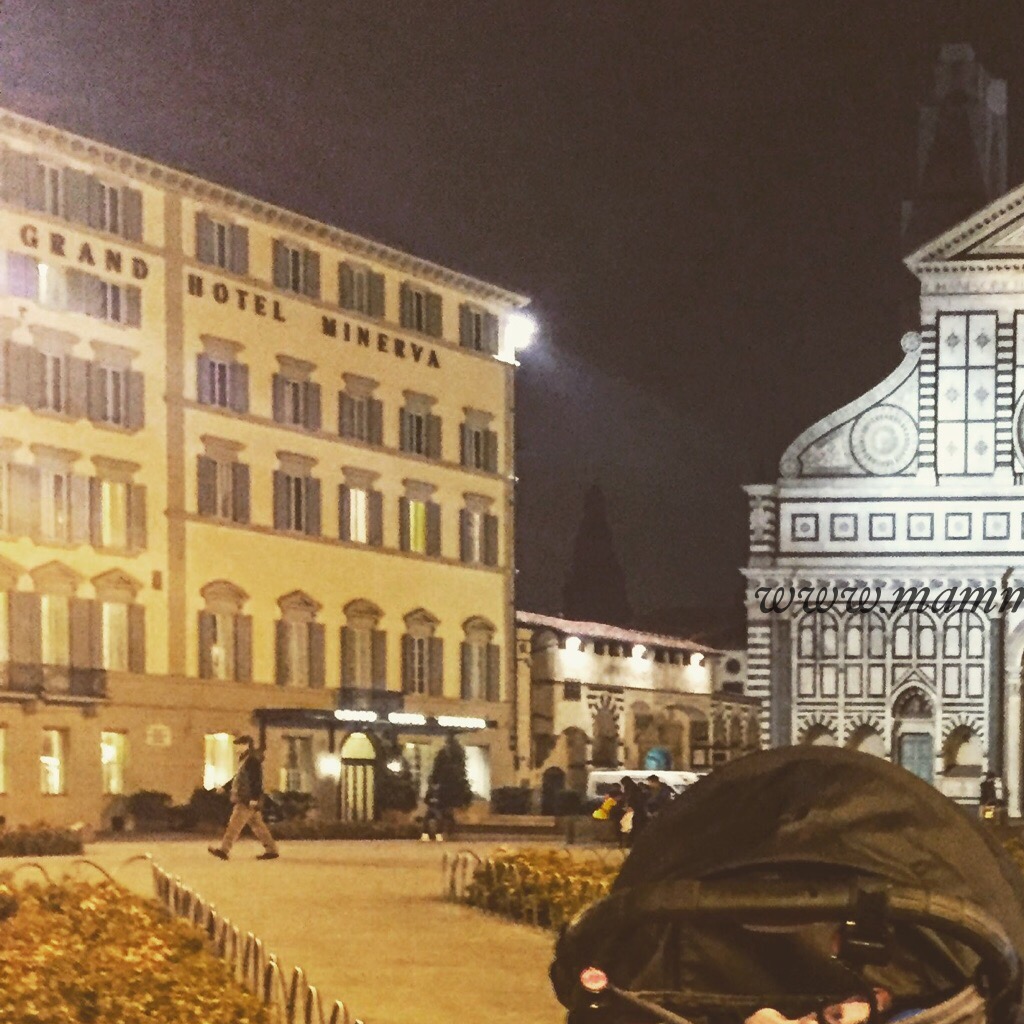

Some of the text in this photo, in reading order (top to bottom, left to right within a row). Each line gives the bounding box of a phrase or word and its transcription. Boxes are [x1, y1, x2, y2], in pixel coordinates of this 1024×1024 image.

[20, 224, 441, 369] GRAND HOTEL MINERVA
